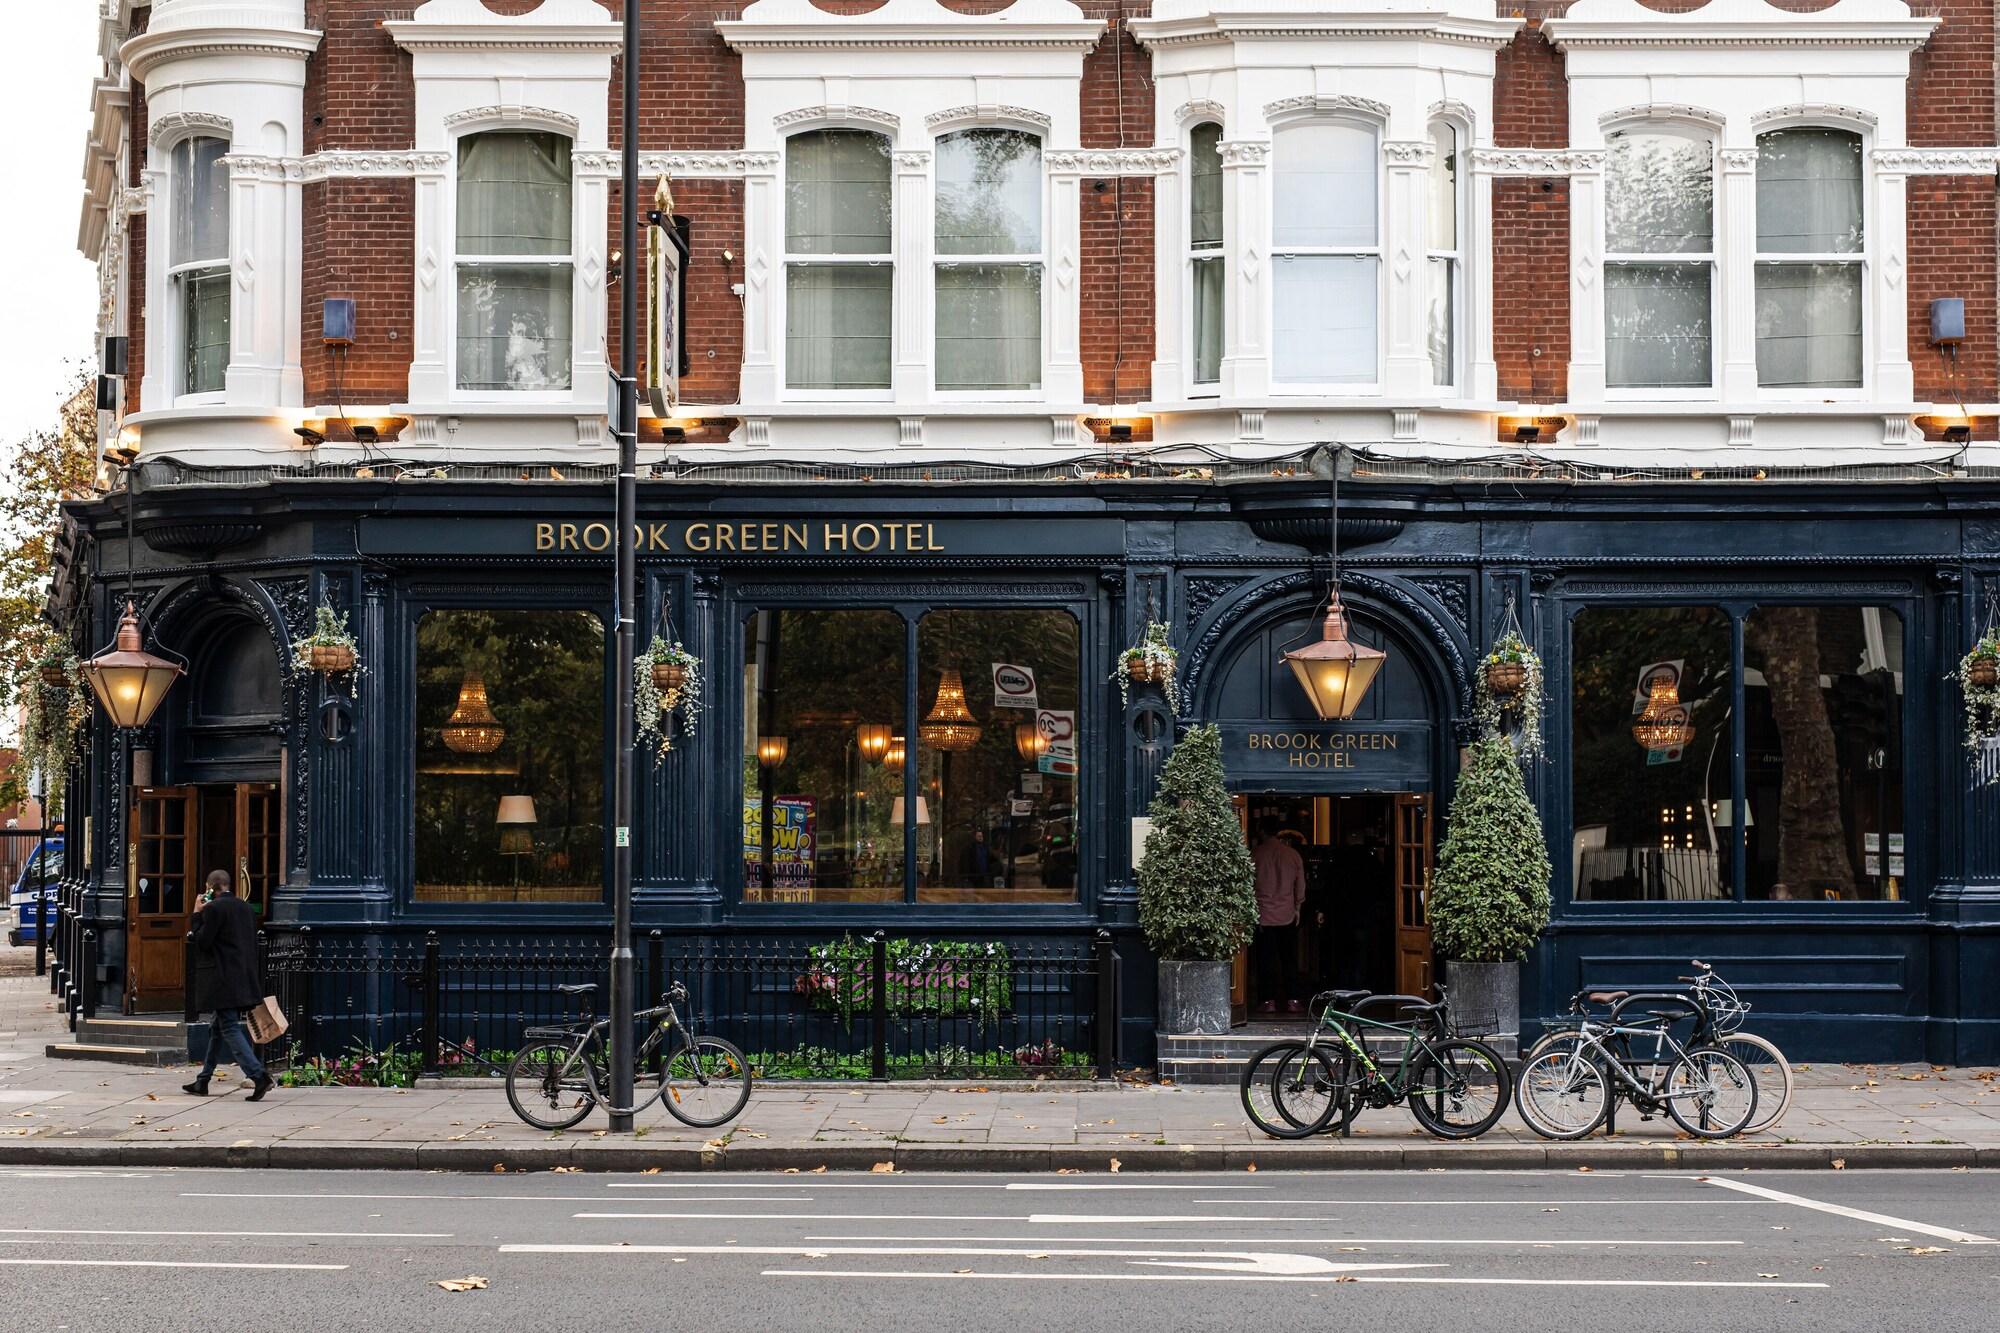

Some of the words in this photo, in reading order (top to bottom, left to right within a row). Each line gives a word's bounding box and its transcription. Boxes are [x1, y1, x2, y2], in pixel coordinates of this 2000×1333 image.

[685, 522, 809, 553] GREEN
[824, 522, 945, 553] HOTEL
[1248, 733, 1321, 750] BROOK
[1329, 733, 1397, 750] GREEN
[1289, 752, 1356, 768] HOTEL
